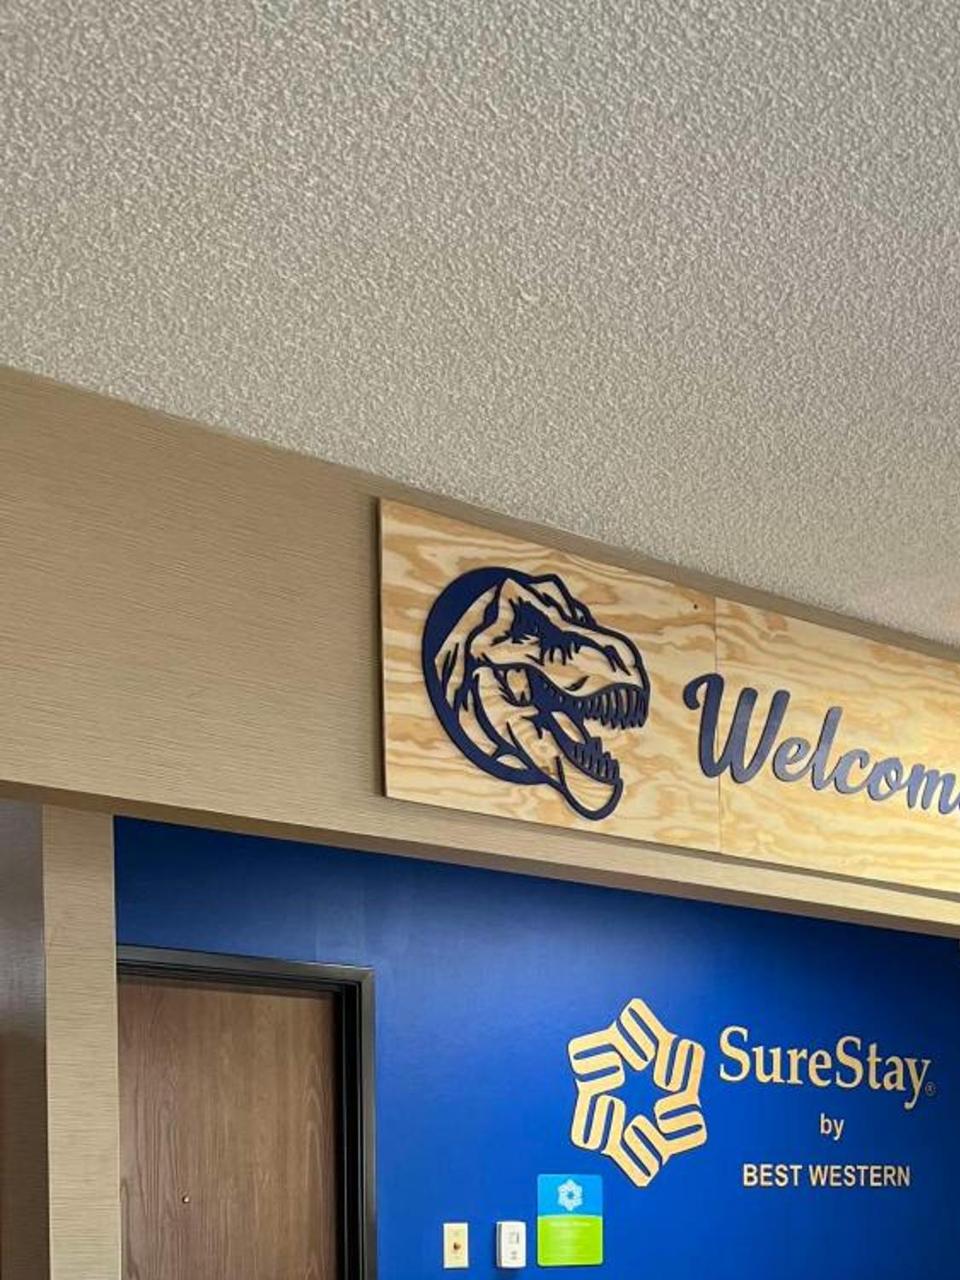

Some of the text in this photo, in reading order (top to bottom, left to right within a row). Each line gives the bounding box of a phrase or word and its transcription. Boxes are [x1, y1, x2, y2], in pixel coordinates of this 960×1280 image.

[819, 1113, 844, 1140] by
[742, 1163, 911, 1187] BEST WESTERN
